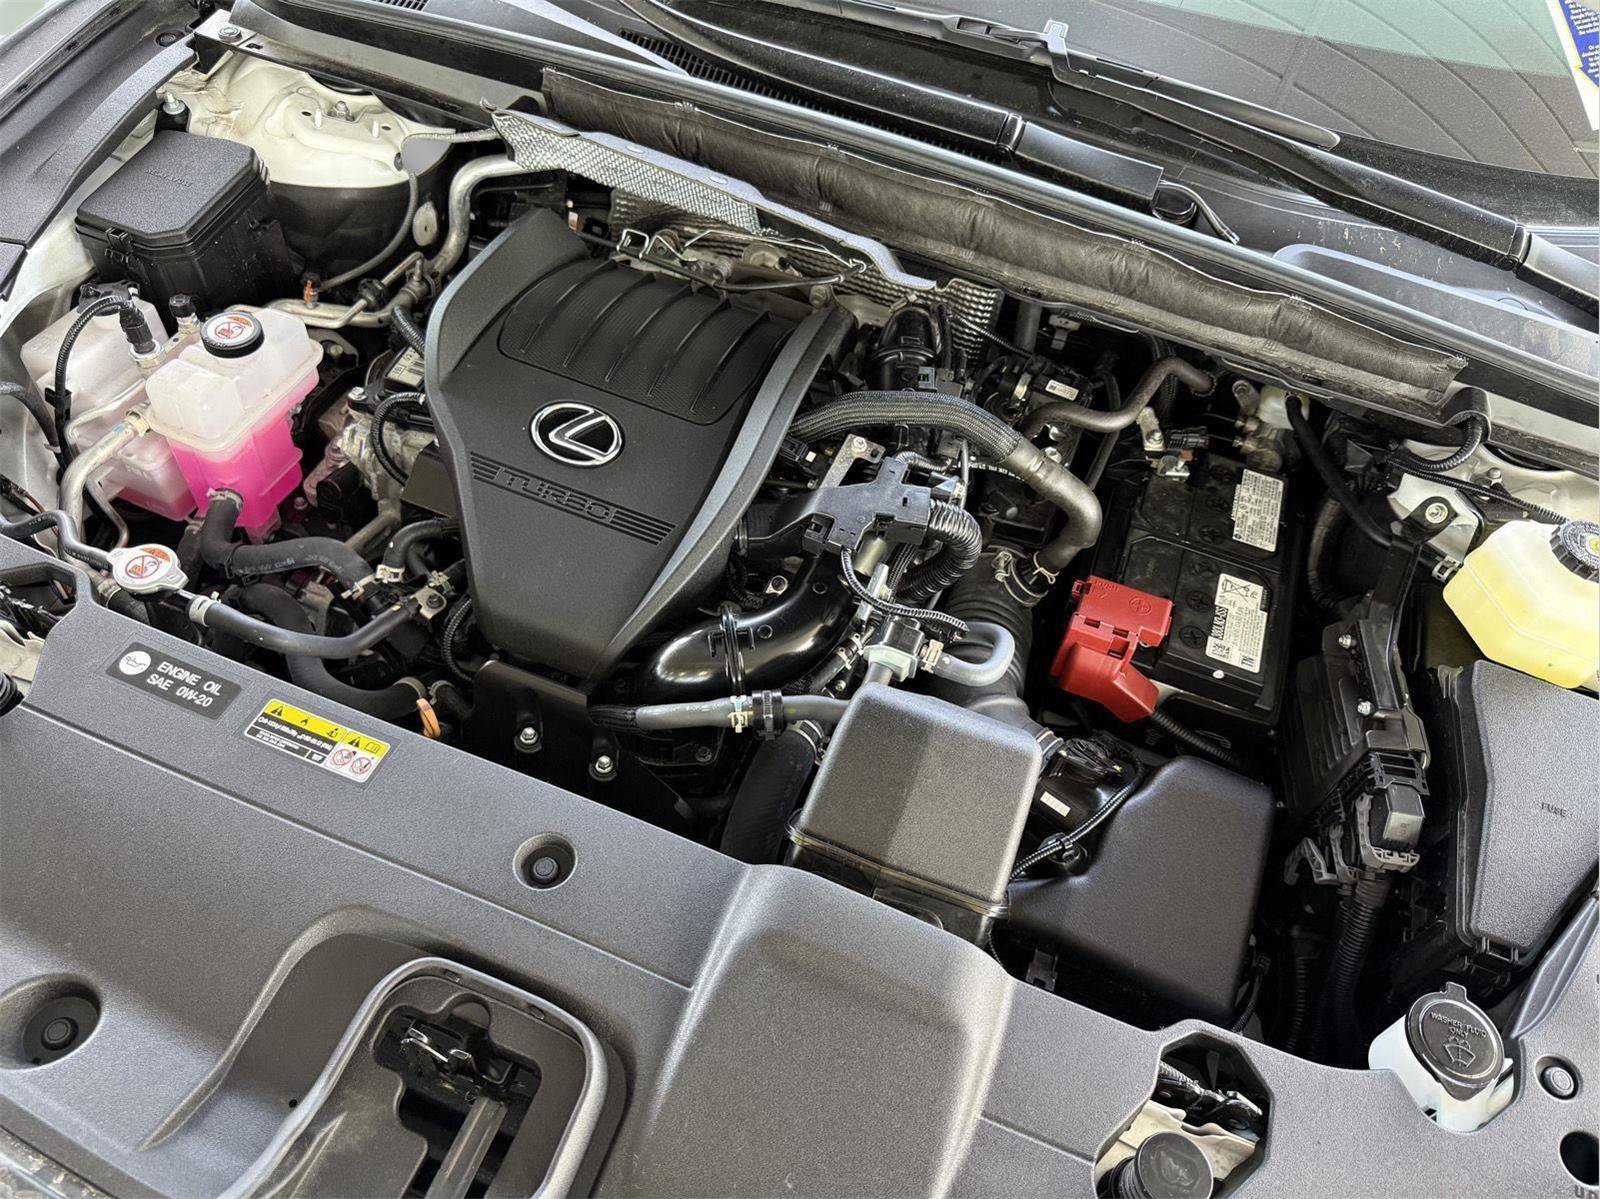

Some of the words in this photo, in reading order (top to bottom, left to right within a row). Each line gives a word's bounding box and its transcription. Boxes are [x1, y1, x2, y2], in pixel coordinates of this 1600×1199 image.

[503, 469, 611, 520] TURBO
[146, 673, 174, 691] SAE
[175, 686, 213, 707] 0W-20
[157, 661, 201, 686] ENGINE
[203, 681, 223, 696] OIL
[1541, 802, 1567, 817] FUSE
[1431, 1012, 1462, 1028] WASHER
[1467, 1024, 1487, 1037] FLUID
[1448, 1026, 1469, 1039] ONLY
